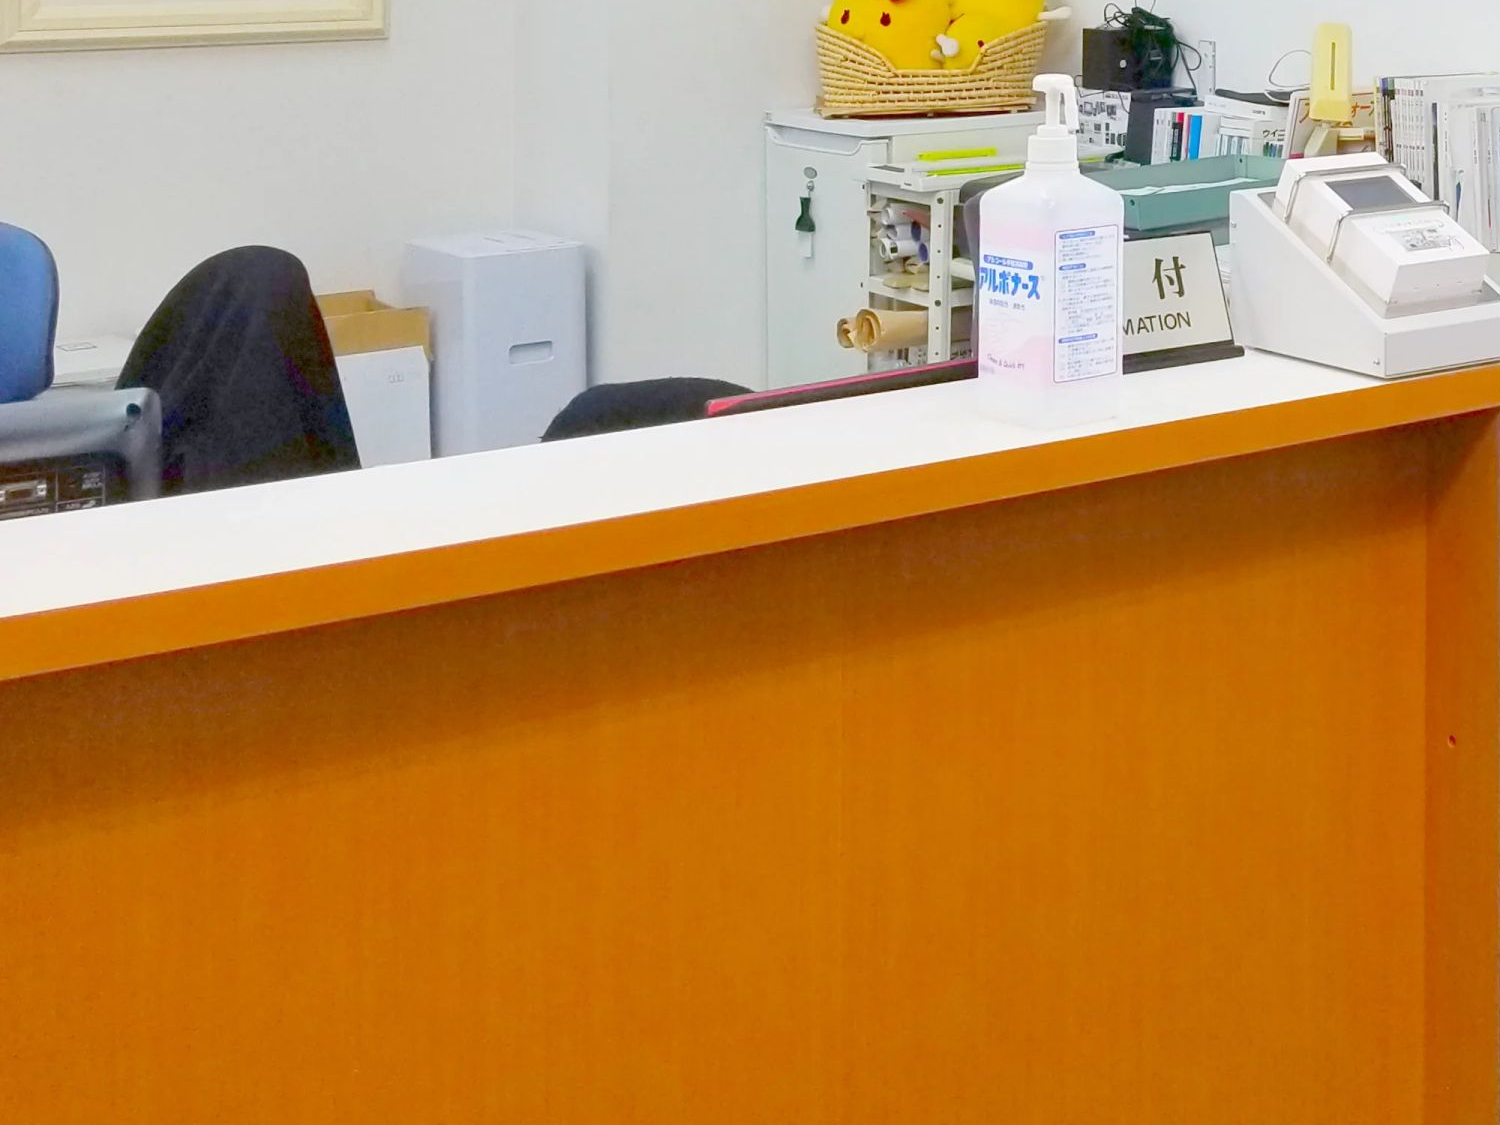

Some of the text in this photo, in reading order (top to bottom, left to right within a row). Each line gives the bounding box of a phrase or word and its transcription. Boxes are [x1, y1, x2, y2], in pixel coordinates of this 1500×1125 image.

[979, 266, 1041, 301] アルボナース
[1152, 256, 1186, 300] 付
